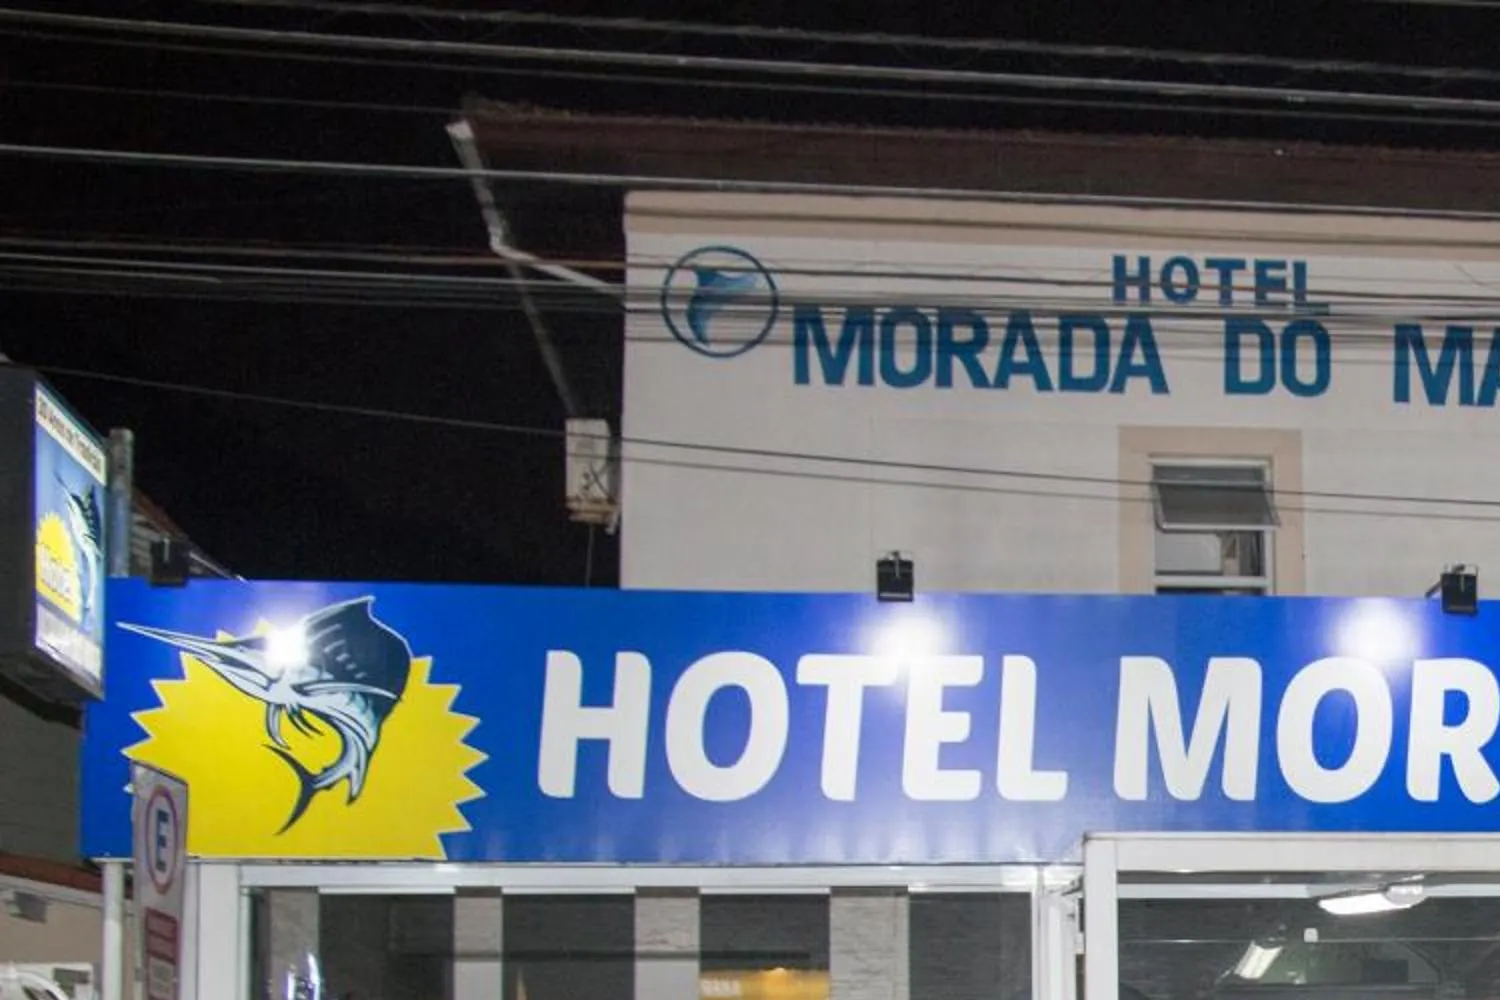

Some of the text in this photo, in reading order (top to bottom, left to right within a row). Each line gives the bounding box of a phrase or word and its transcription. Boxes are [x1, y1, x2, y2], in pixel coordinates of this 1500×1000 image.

[1112, 254, 1328, 314] HOTEL
[793, 305, 1168, 395] MORADA
[1223, 318, 1332, 397] DO
[538, 650, 1068, 802] HOTEL
